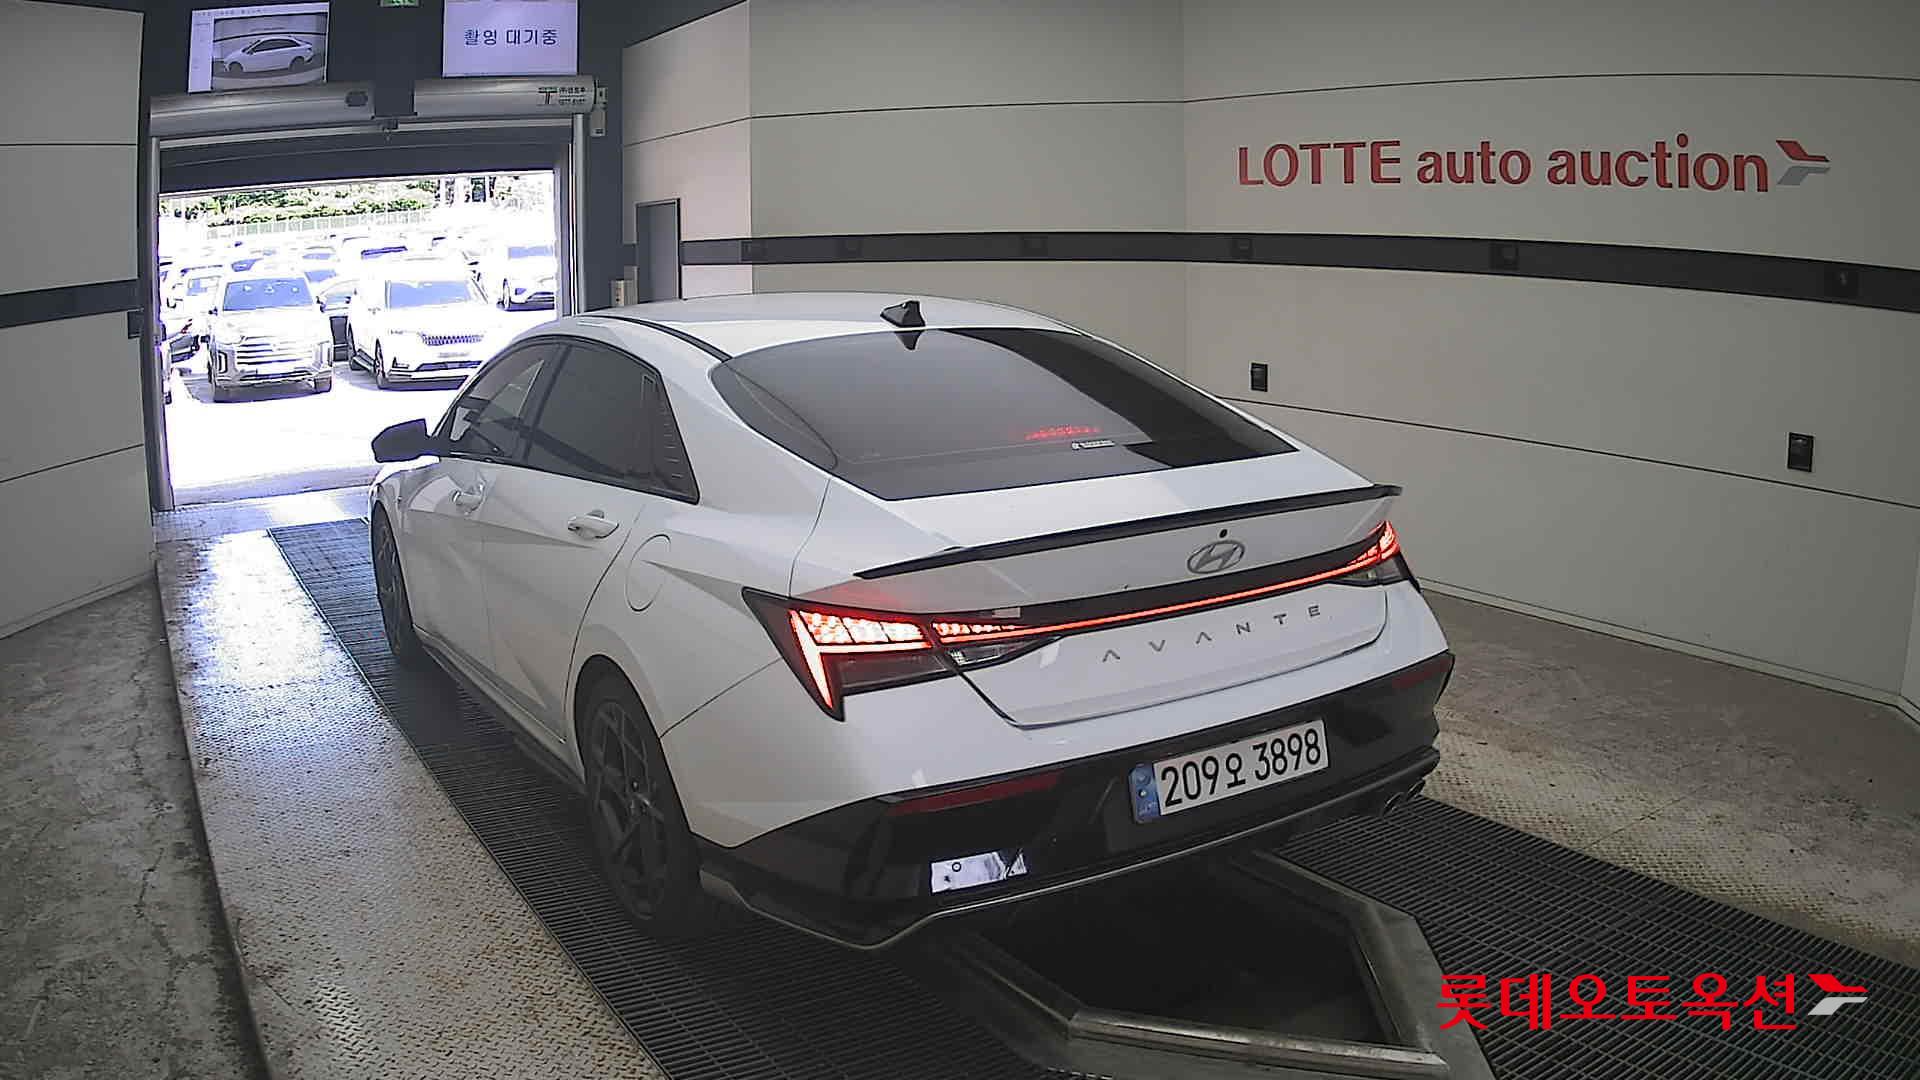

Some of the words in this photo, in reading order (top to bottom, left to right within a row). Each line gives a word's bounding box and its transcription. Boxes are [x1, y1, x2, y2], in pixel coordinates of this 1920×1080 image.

[464, 29, 497, 46] 촬영
[506, 29, 557, 46] 대기중
[1239, 139, 1401, 187] LOTTE
[1417, 140, 1531, 186] auto
[1547, 133, 1769, 193] auction
[1102, 605, 1321, 663] AVANTE
[1161, 752, 1246, 807] 209오
[1252, 728, 1321, 781] 3898
